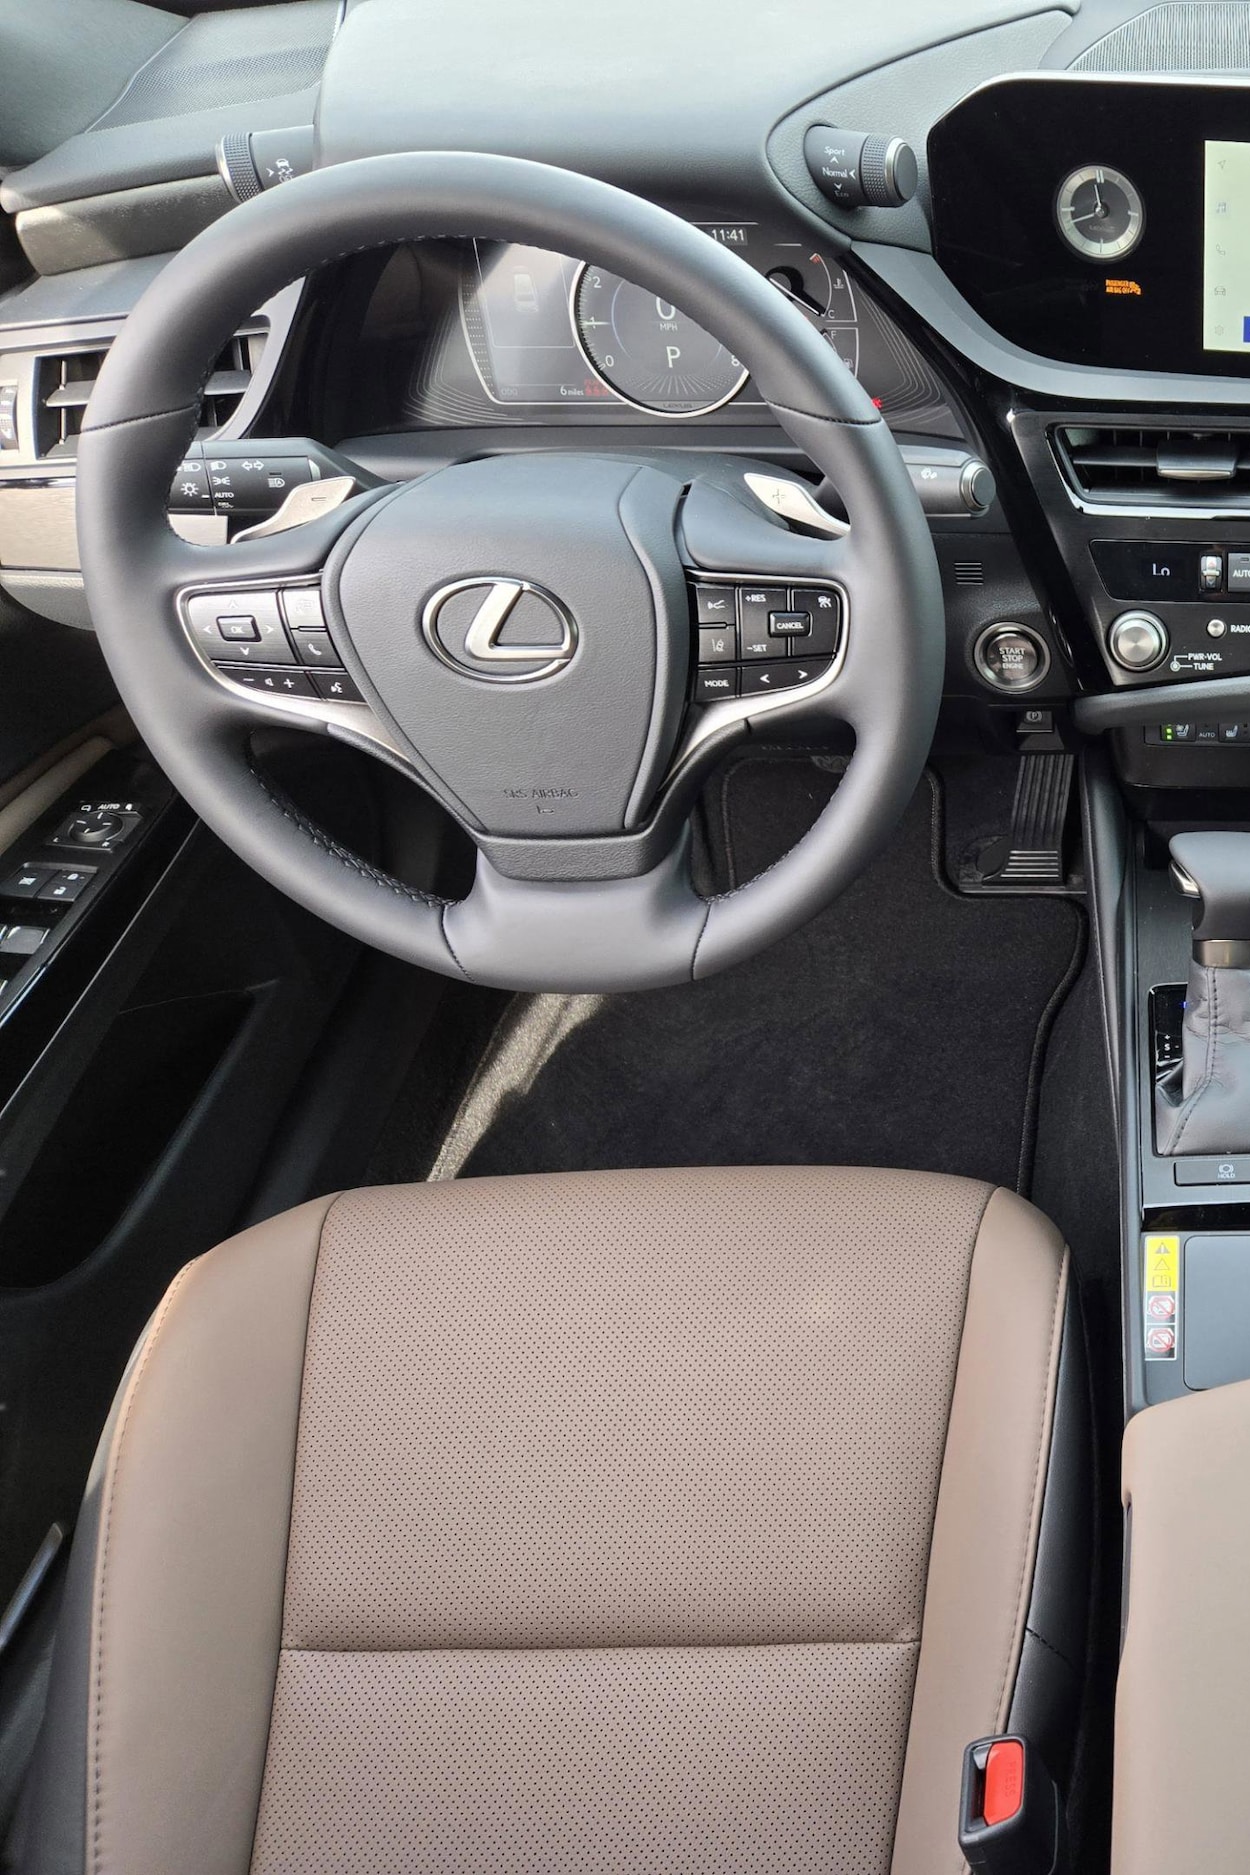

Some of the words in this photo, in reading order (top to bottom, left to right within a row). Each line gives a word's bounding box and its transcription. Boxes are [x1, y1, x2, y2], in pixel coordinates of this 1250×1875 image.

[823, 146, 845, 156] Sport
[822, 167, 848, 178] Normal
[711, 229, 745, 242] 11:41
[827, 310, 835, 319] C
[659, 323, 678, 331] MPH
[830, 331, 837, 339] F
[605, 355, 614, 367] 0
[666, 346, 681, 368] P
[559, 385, 567, 395] 6
[567, 388, 585, 396] miles
[230, 626, 245, 634] OK
[776, 622, 804, 630] CANCEL
[999, 646, 1025, 655] START
[1193, 662, 1215, 670] TUNE
[503, 788, 528, 798] SRS
[531, 788, 579, 799] AIRBAG
